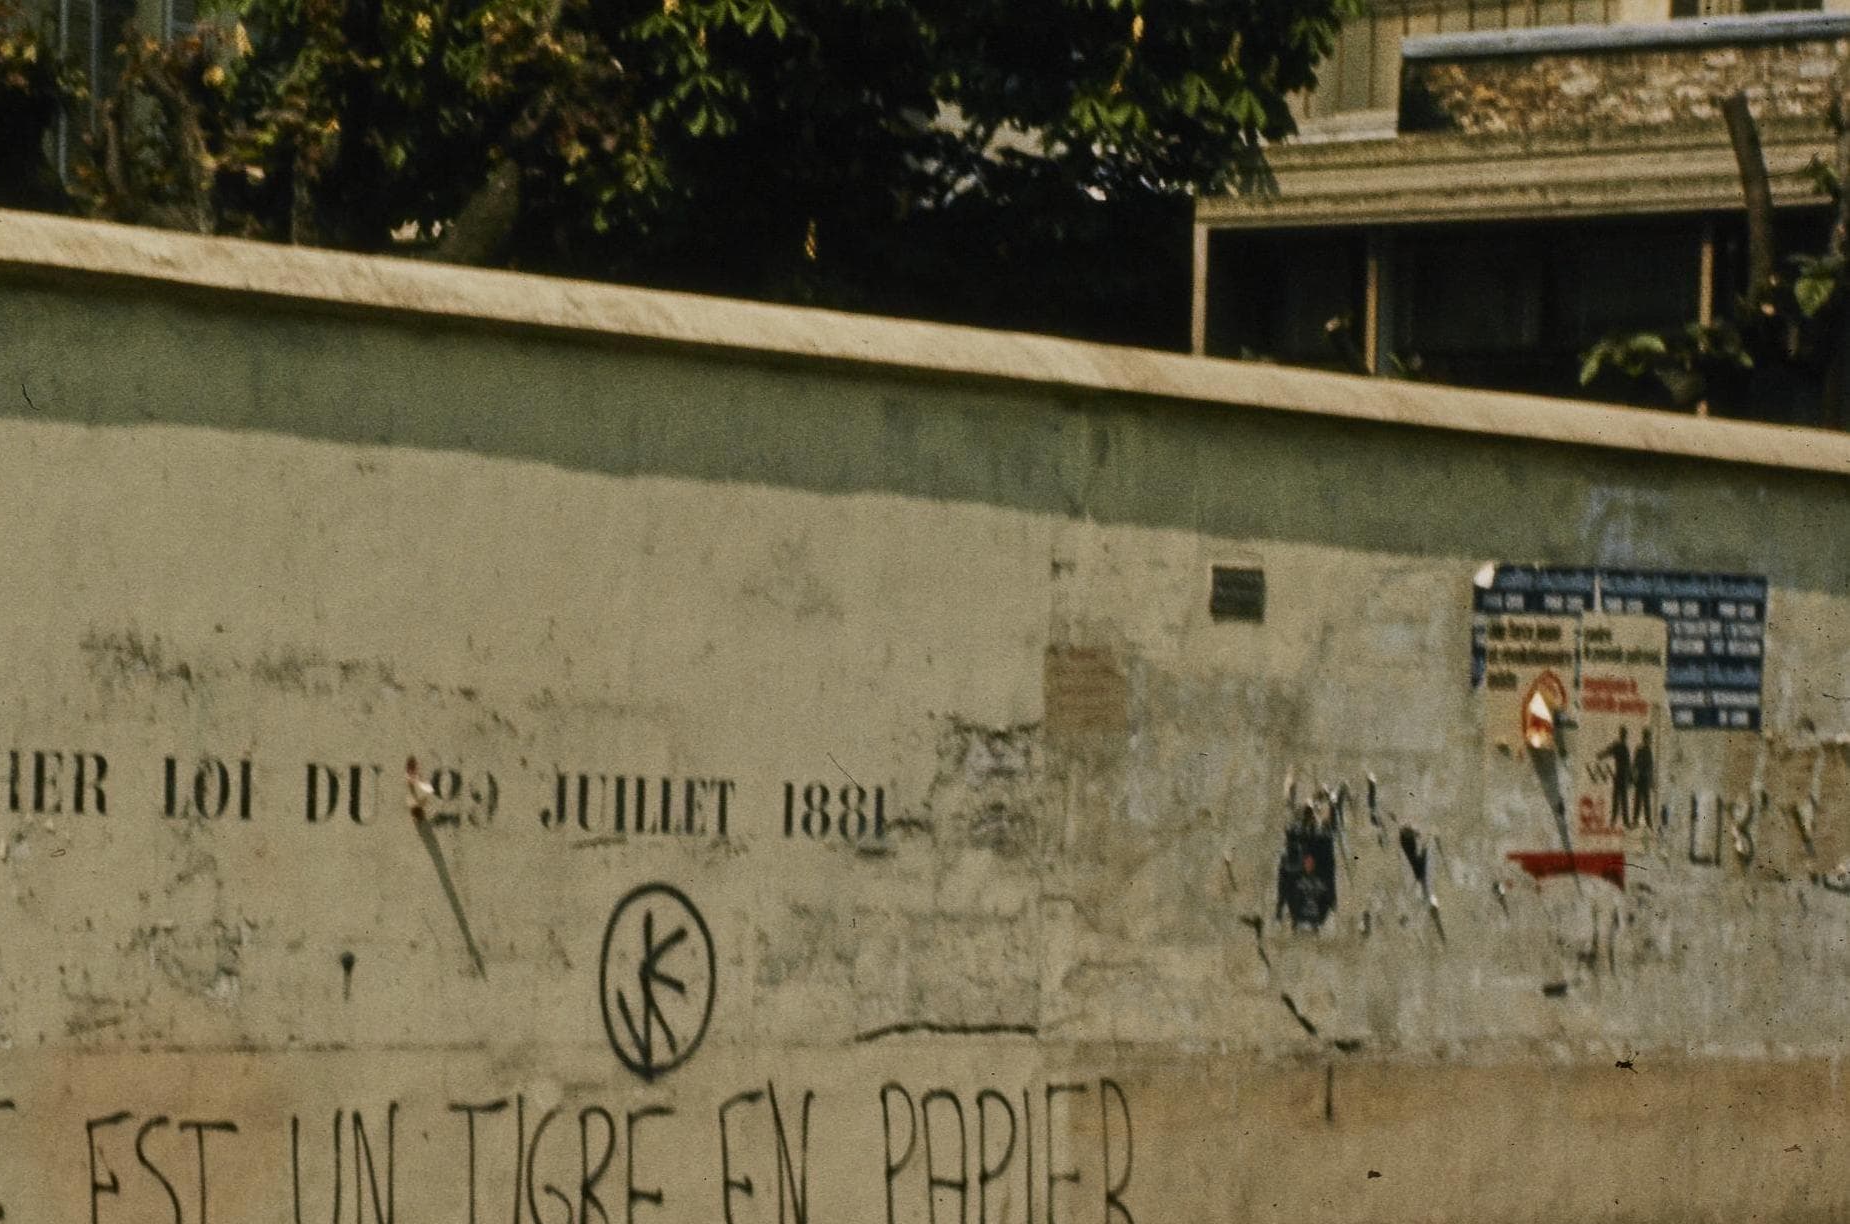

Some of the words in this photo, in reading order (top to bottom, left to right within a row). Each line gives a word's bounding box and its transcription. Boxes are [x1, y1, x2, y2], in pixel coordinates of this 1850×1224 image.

[162, 756, 255, 822] LOI
[306, 762, 385, 825] DU
[539, 772, 737, 837] JUILLET
[782, 781, 889, 842] 1881
